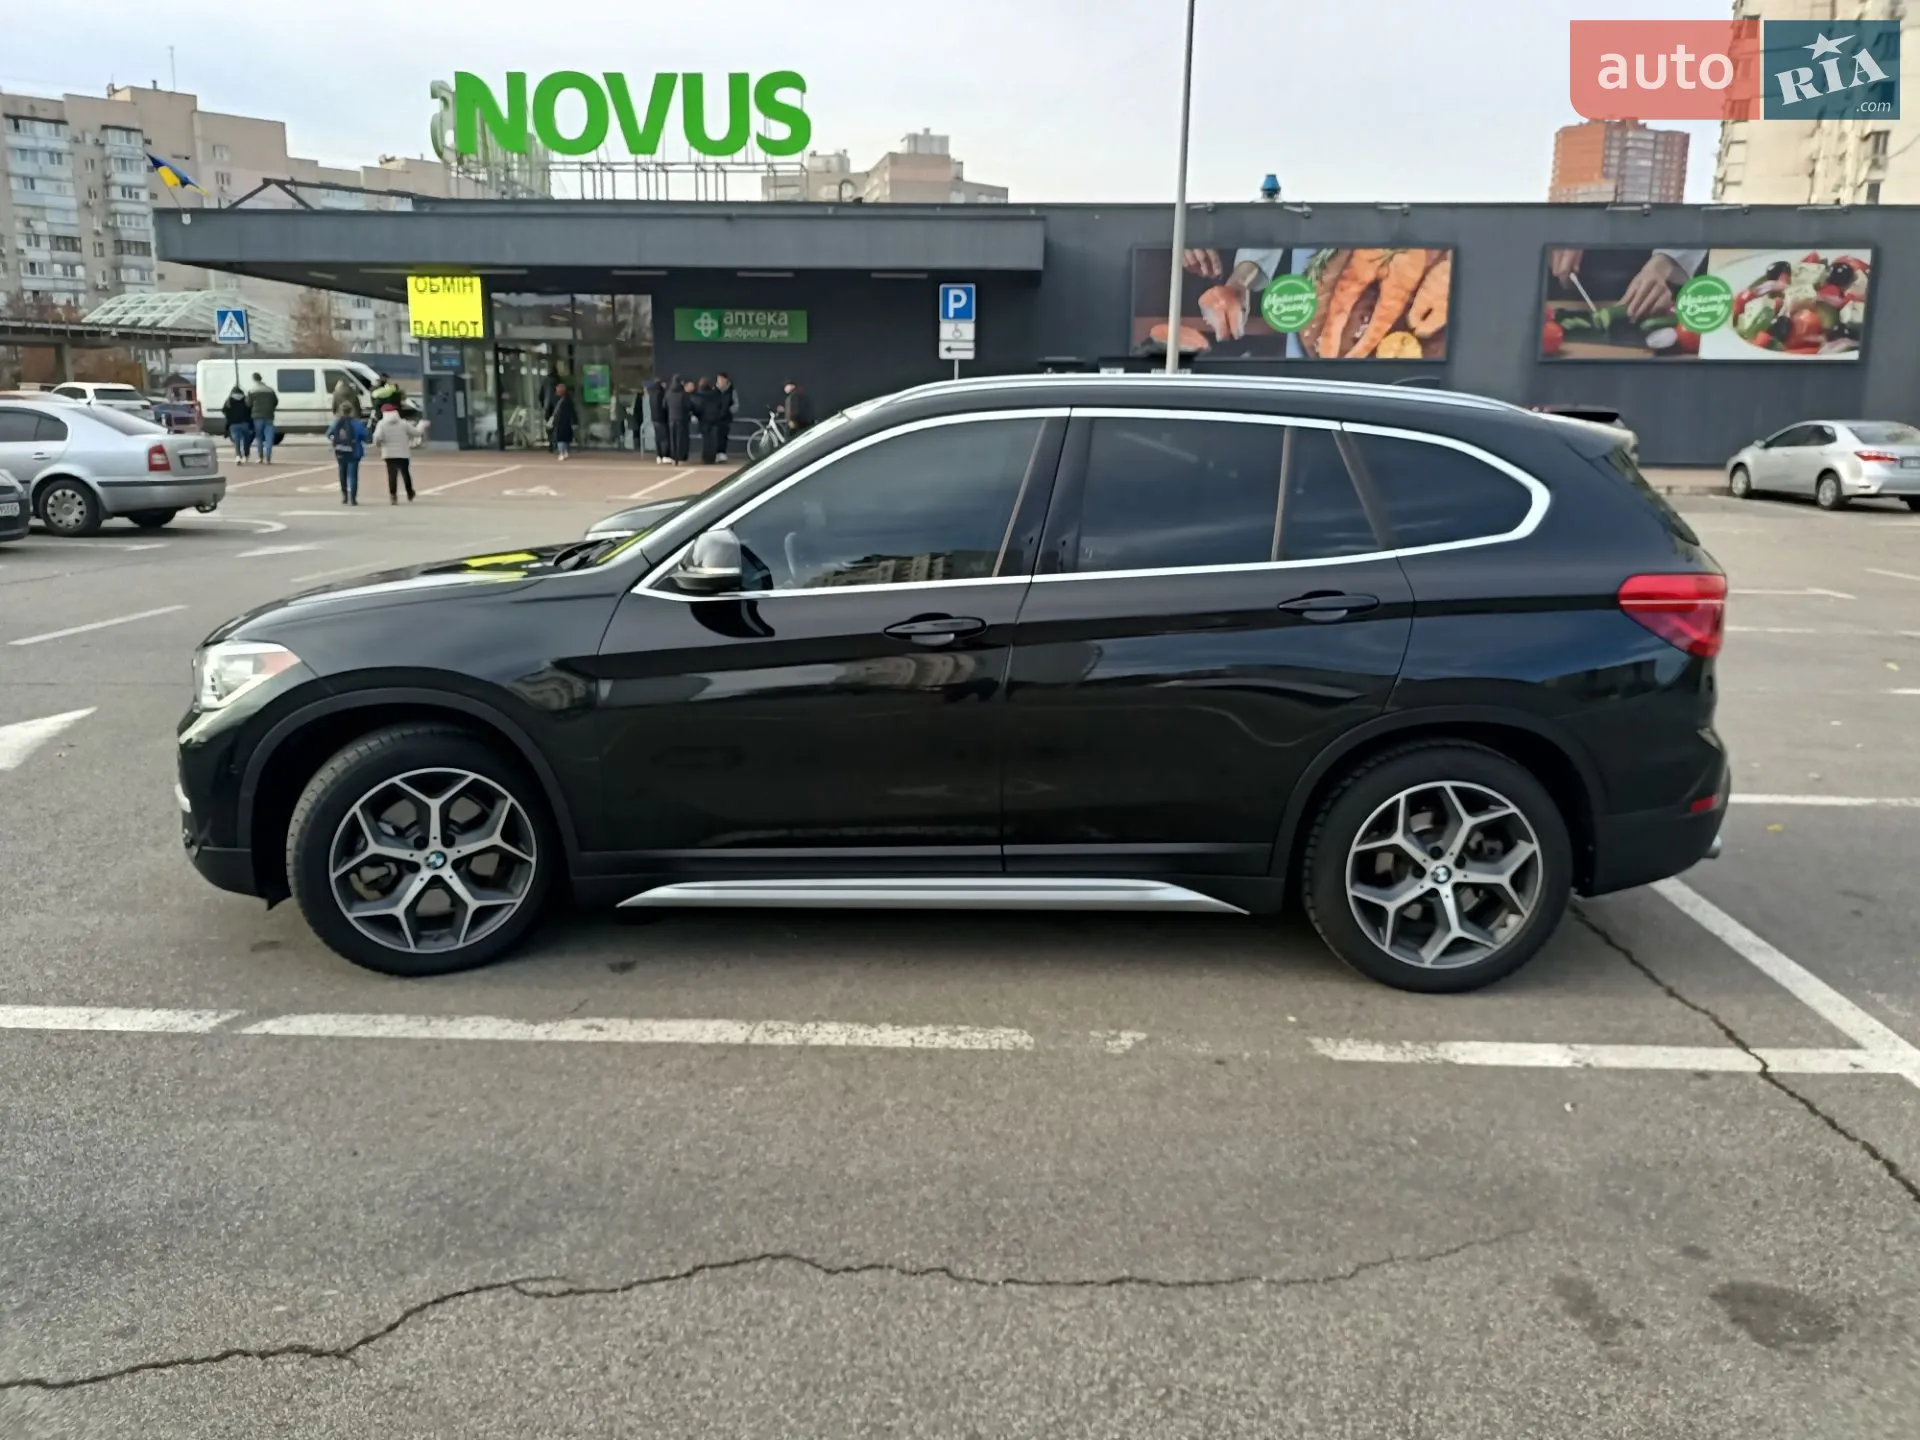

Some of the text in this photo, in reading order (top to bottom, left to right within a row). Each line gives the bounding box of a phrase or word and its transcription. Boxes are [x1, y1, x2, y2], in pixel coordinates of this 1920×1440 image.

[454, 70, 812, 157] NOVUS
[414, 275, 474, 294] ОБМІН
[948, 288, 968, 318] P
[723, 310, 788, 326] аптека
[413, 320, 479, 337] ВАЛЮТ
